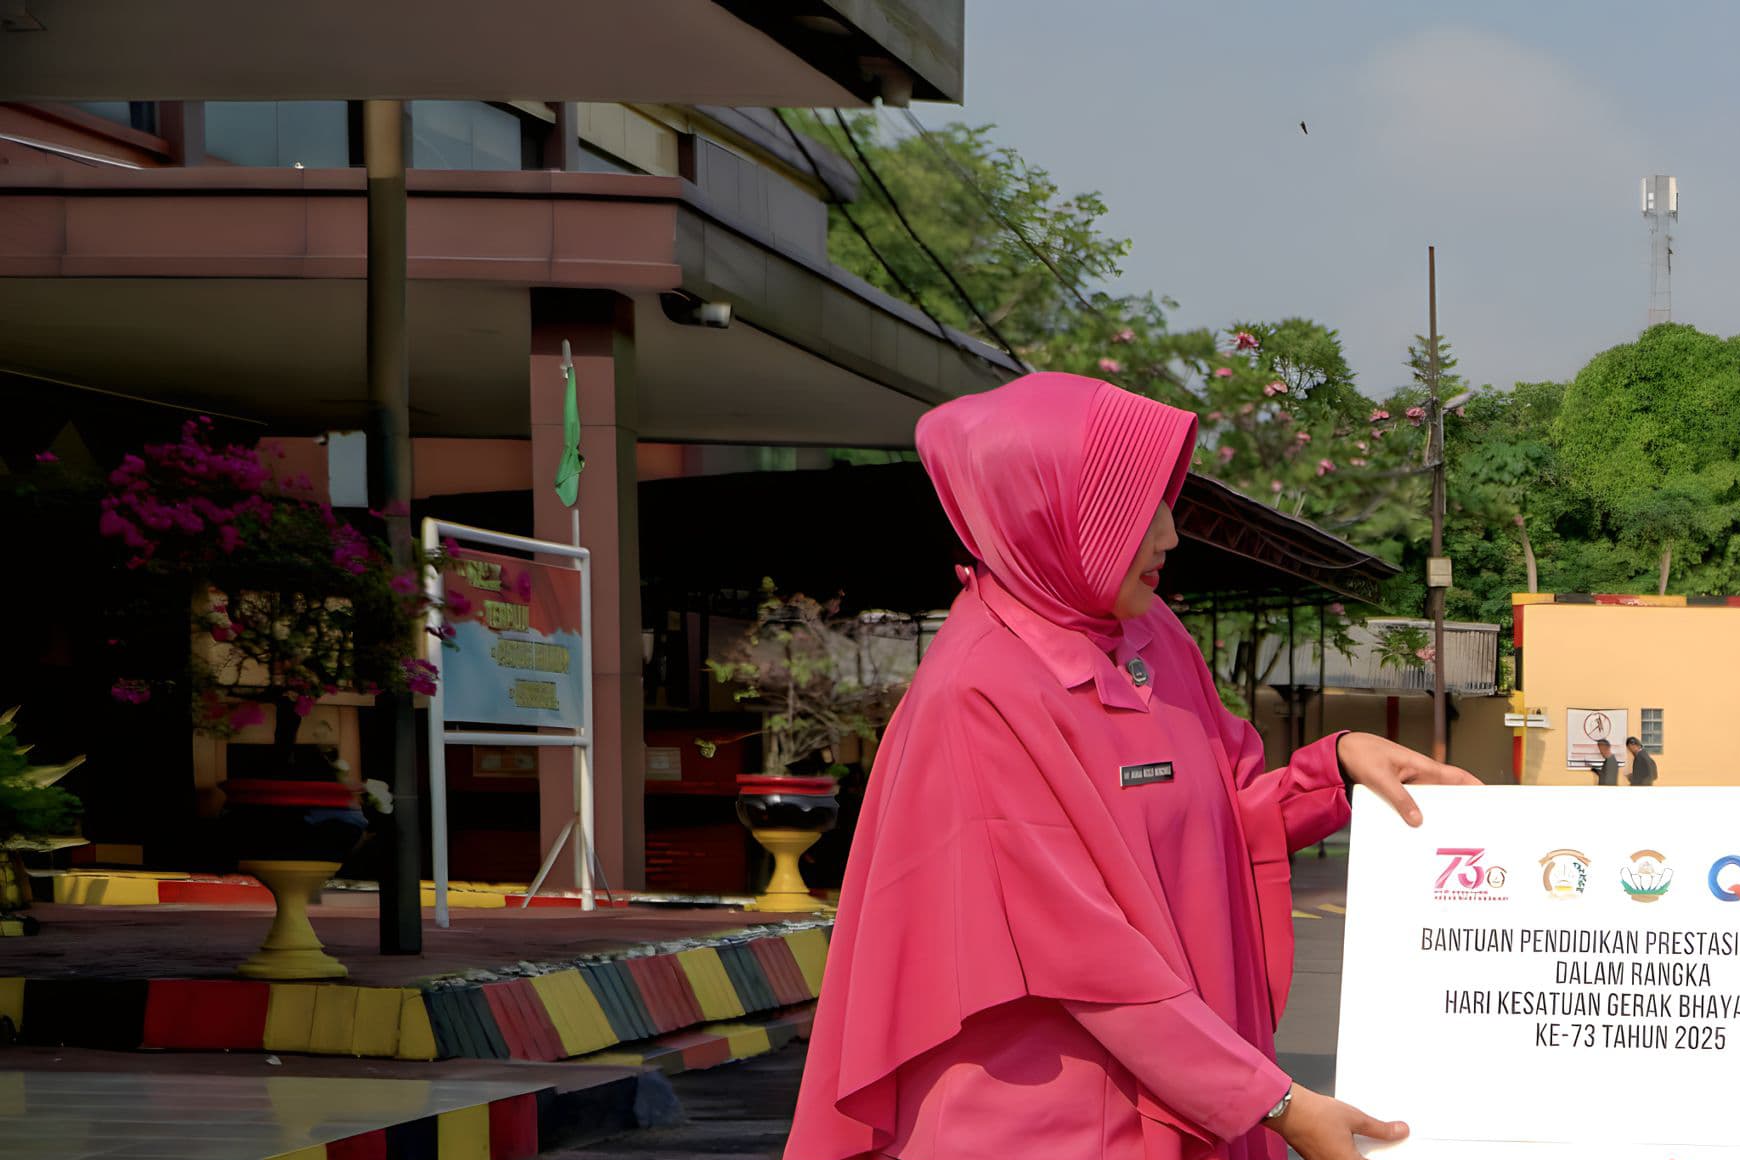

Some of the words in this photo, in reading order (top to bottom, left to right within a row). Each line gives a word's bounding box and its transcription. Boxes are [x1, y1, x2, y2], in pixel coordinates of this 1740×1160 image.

[1421, 927, 1512, 953] BANTUAN
[1520, 929, 1639, 955] PENDIDIKAN
[1645, 931, 1739, 956] PRESTASI
[1555, 960, 1624, 985] DALAM
[1631, 962, 1711, 987] RANGKA
[1445, 989, 1491, 1015] HARI
[1497, 990, 1601, 1017] KESATUAN
[1607, 992, 1672, 1018] GERAK
[1535, 1022, 1595, 1048] KE-73
[1601, 1024, 1668, 1050] TAHUN
[1674, 1025, 1726, 1050] 2025
